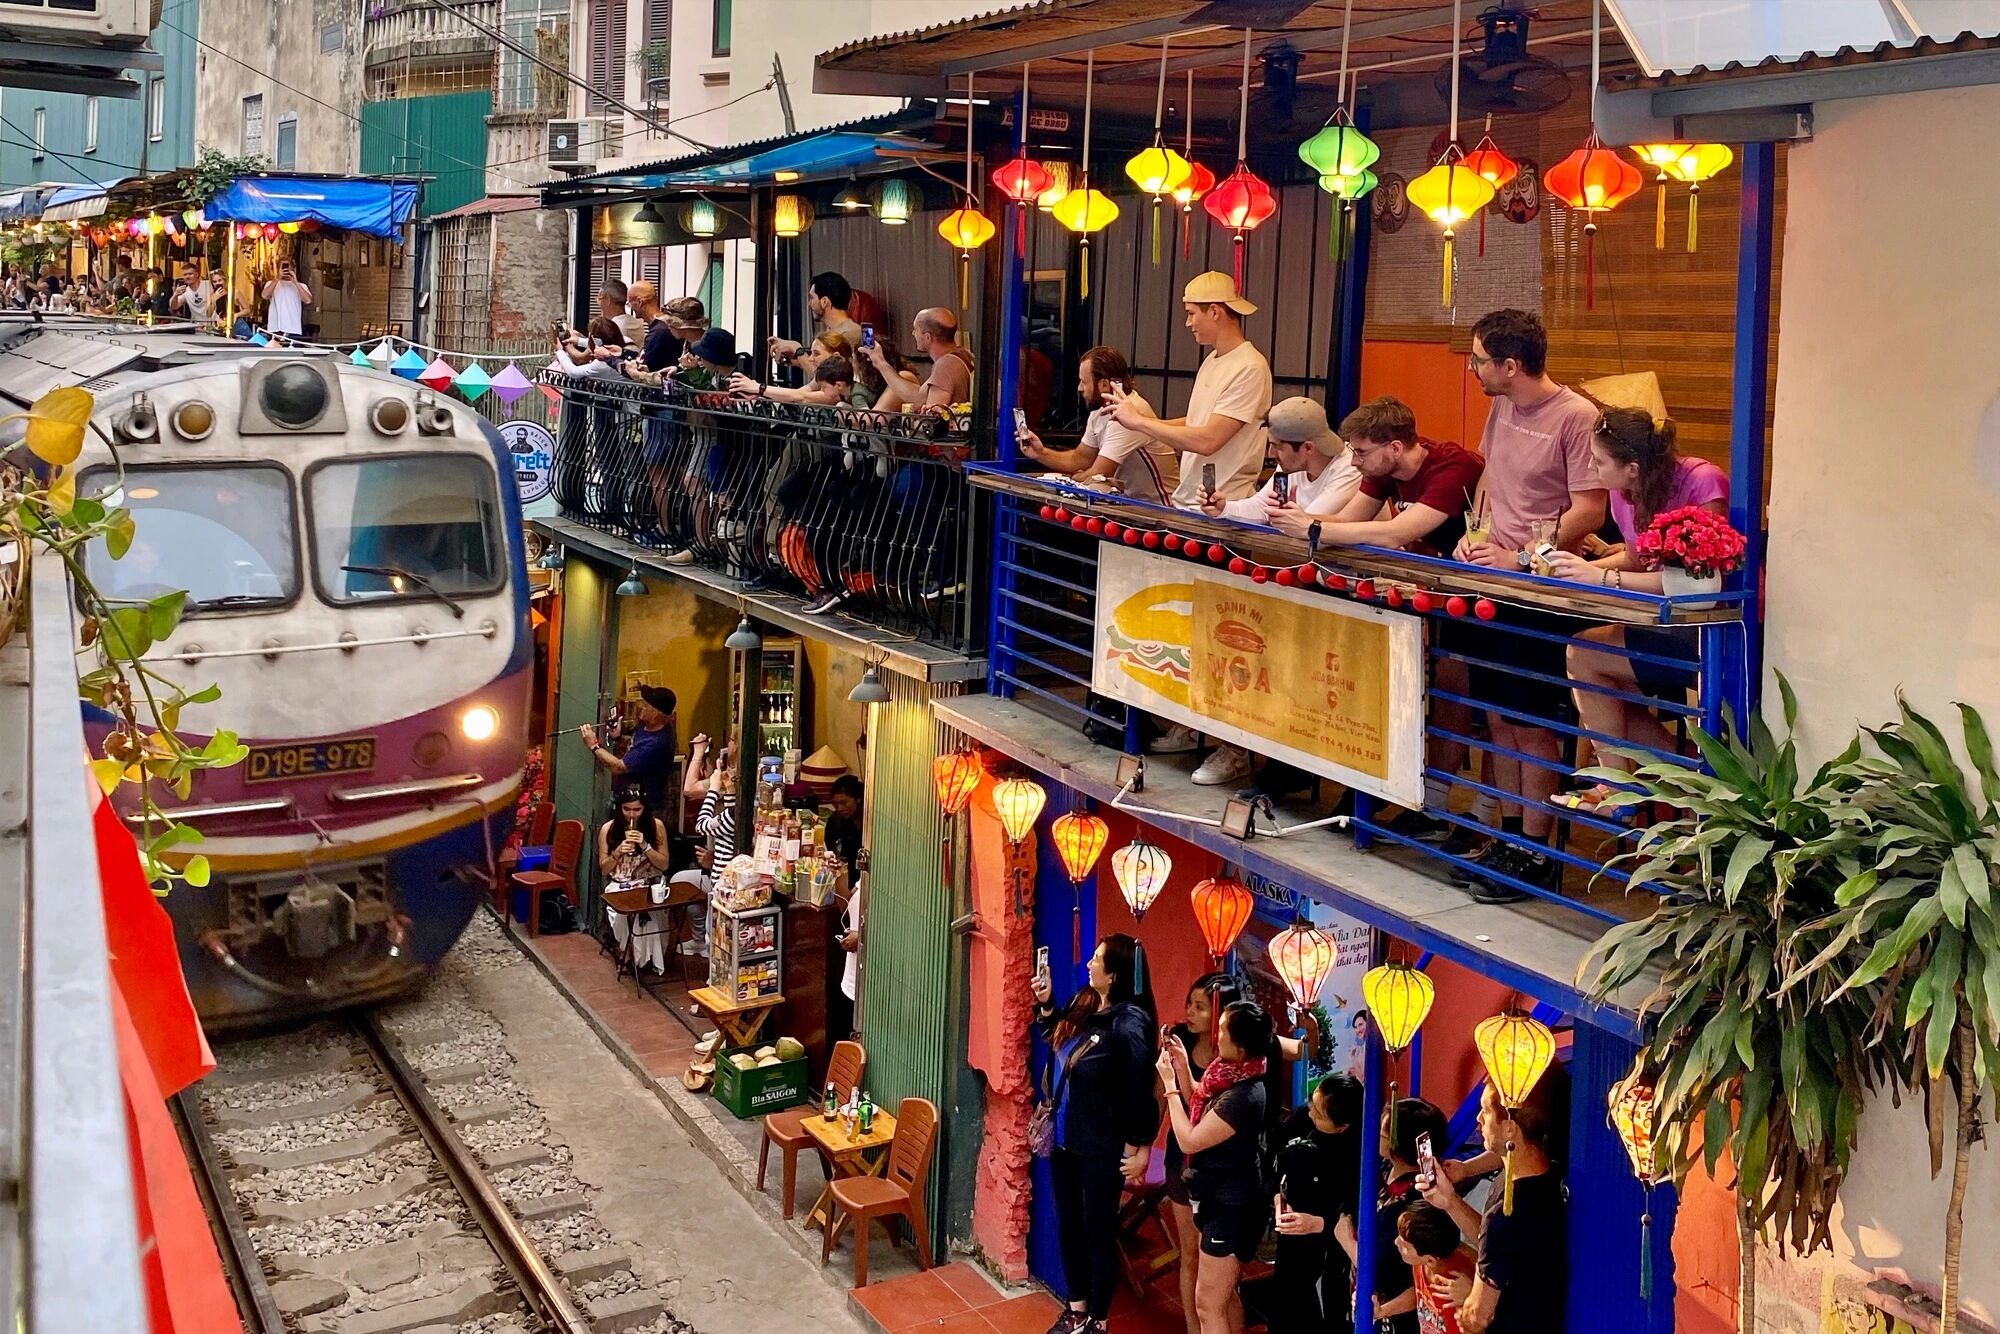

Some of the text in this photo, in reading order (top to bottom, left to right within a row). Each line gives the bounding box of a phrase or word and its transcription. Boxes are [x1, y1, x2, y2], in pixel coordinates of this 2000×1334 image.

[1215, 601, 1263, 625] BANH MI
[1244, 874, 1297, 909] ALASKA
